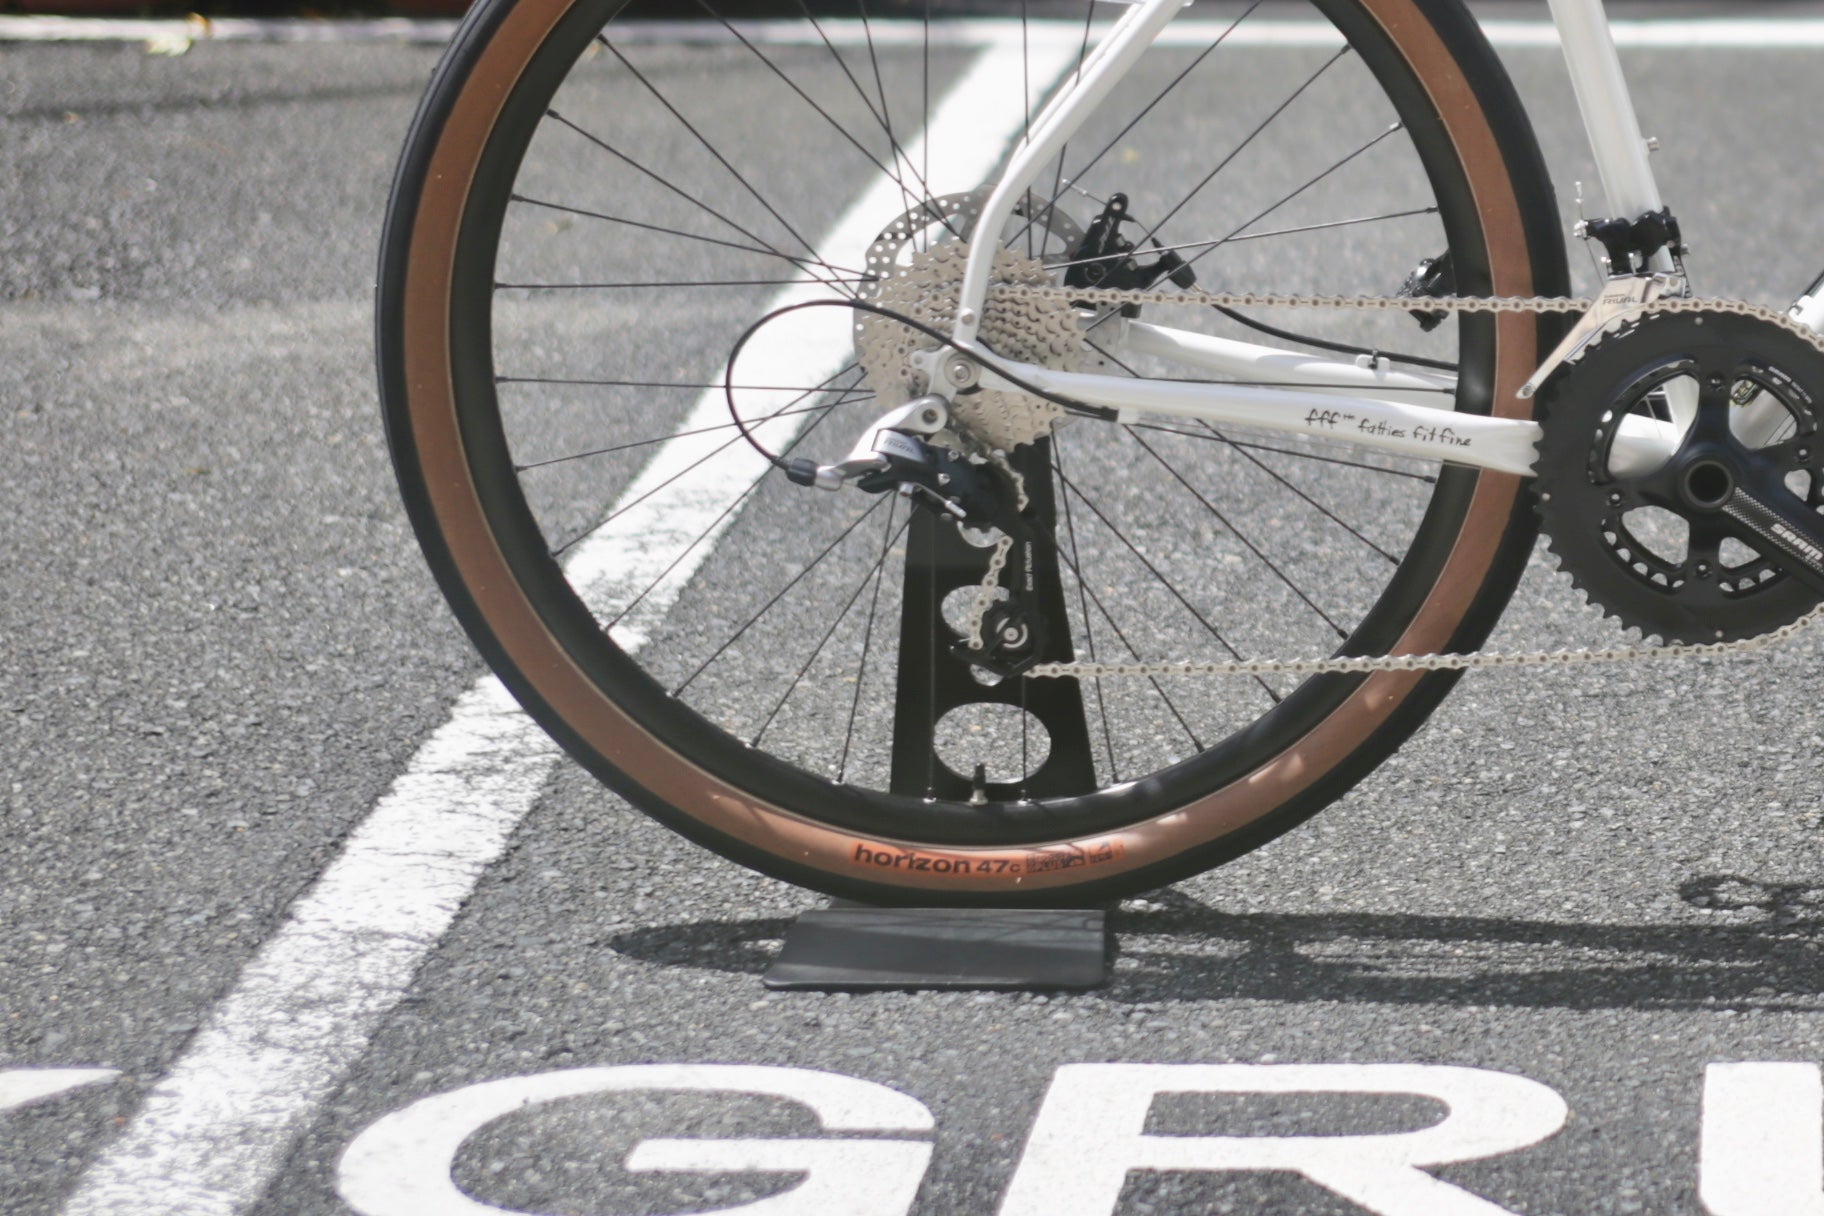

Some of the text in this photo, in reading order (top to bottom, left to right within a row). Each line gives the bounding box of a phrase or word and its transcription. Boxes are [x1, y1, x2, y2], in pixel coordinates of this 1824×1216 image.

[1413, 424, 1437, 442] fit
[1439, 427, 1472, 447] fine
[1770, 523, 1824, 561] SRAM
[854, 843, 972, 875] horizon
